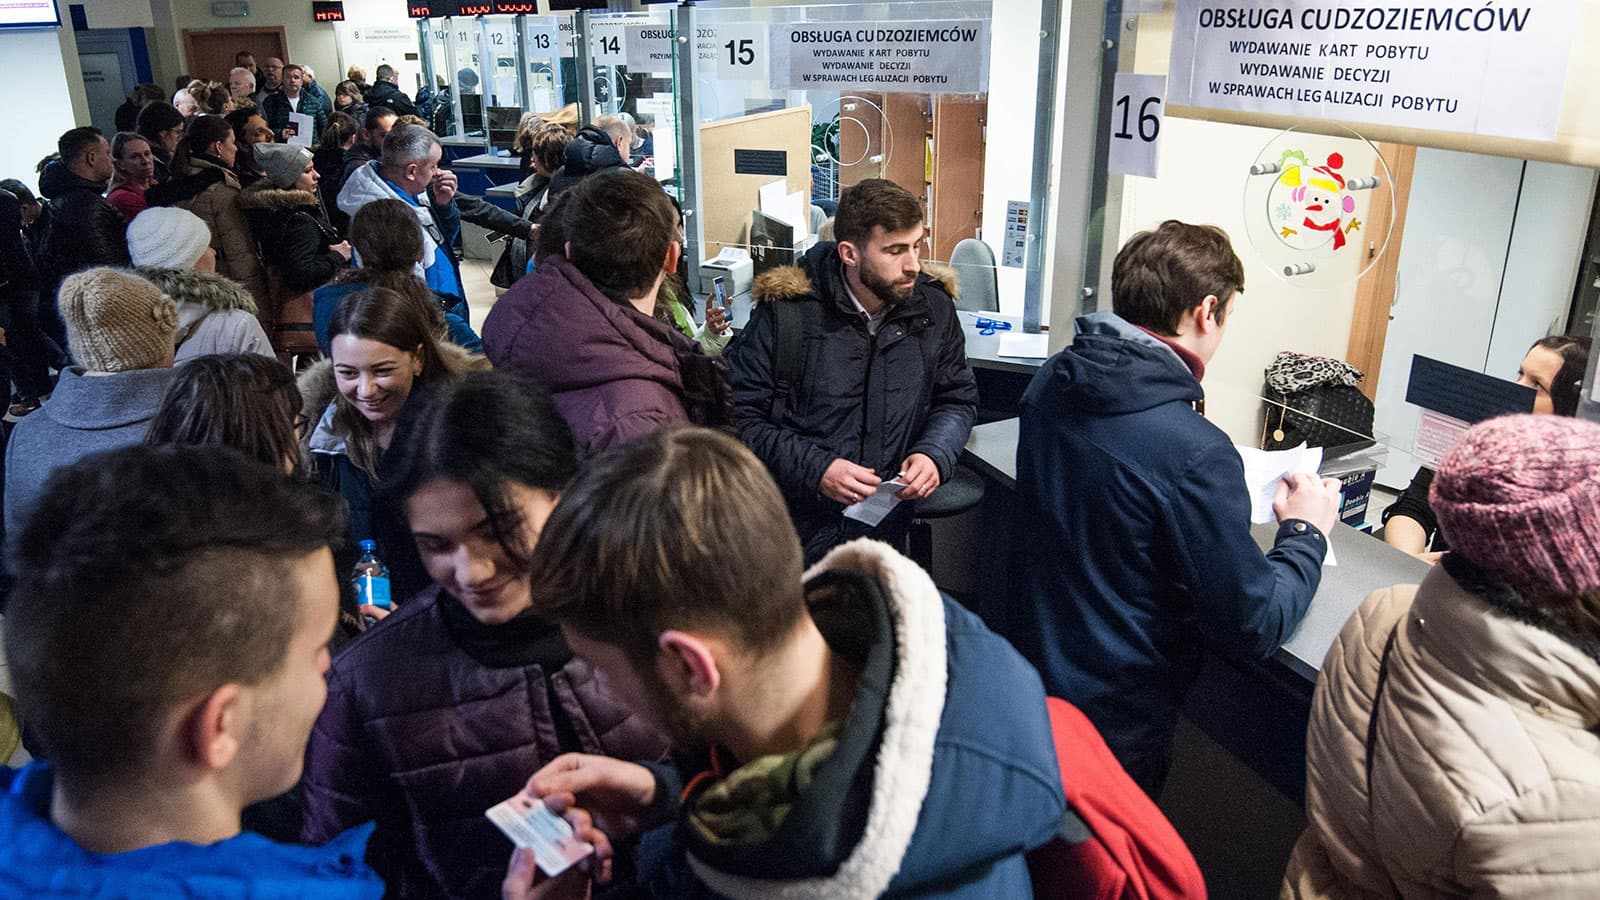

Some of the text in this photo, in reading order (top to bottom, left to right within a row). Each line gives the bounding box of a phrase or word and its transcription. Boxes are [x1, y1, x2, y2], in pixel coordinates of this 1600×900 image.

[1198, 0, 1532, 33] OBSŁUGA CUDZOZIEMCÓW
[354, 31, 360, 39] 8
[434, 31, 445, 39] 10
[459, 32, 467, 42] 11
[491, 33, 503, 45] 12
[534, 34, 550, 49] 13
[790, 25, 977, 43] OBSŁUGA CUDZOZIEMCÓW
[600, 36, 621, 55] 14
[725, 39, 755, 66] 15
[813, 49, 930, 57] WYDAWANIE KART POBYTU
[1229, 41, 1430, 61] WYDAWANIE KART POBYTU
[822, 61, 911, 70] WYDAWANIE DECYZJI
[1239, 63, 1391, 84] WYDAWANIE DECYZJI
[803, 74, 948, 84] W SPRAWACH LEGALIZACJI POBYTU
[1208, 82, 1459, 114] W SPRAWACH LEGALIZACJI POBYTU
[1114, 95, 1161, 143] 16
